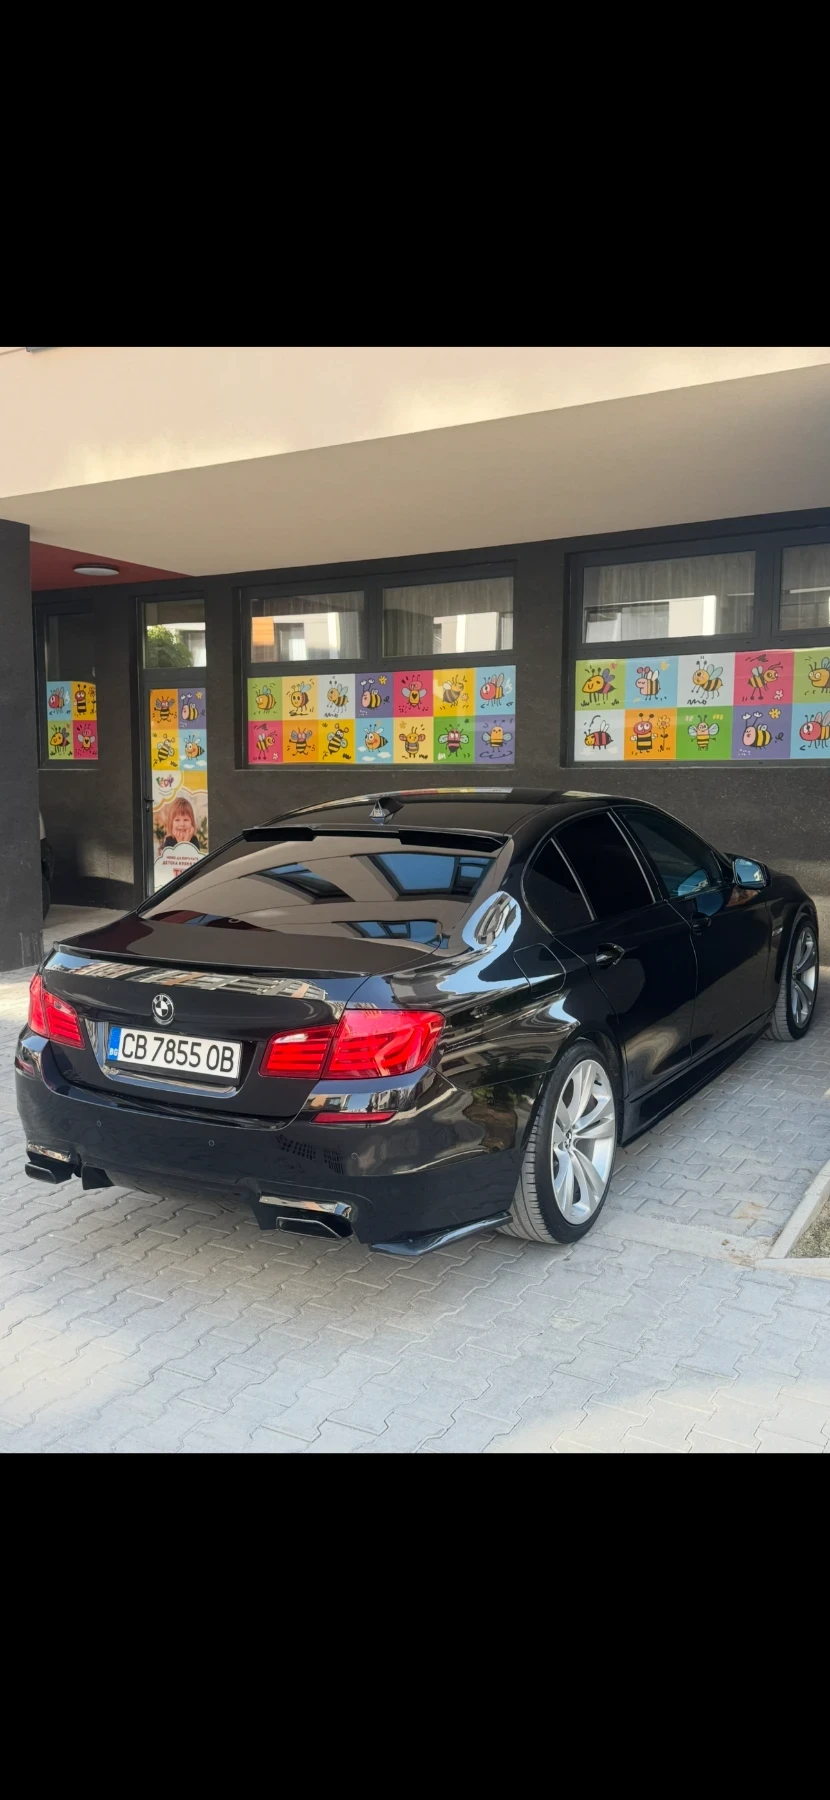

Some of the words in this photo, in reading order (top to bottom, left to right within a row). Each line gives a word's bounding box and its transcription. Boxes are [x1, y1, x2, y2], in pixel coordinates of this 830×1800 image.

[109, 1047, 118, 1056] BG
[122, 1033, 147, 1060] CB
[151, 1036, 202, 1068] 7855
